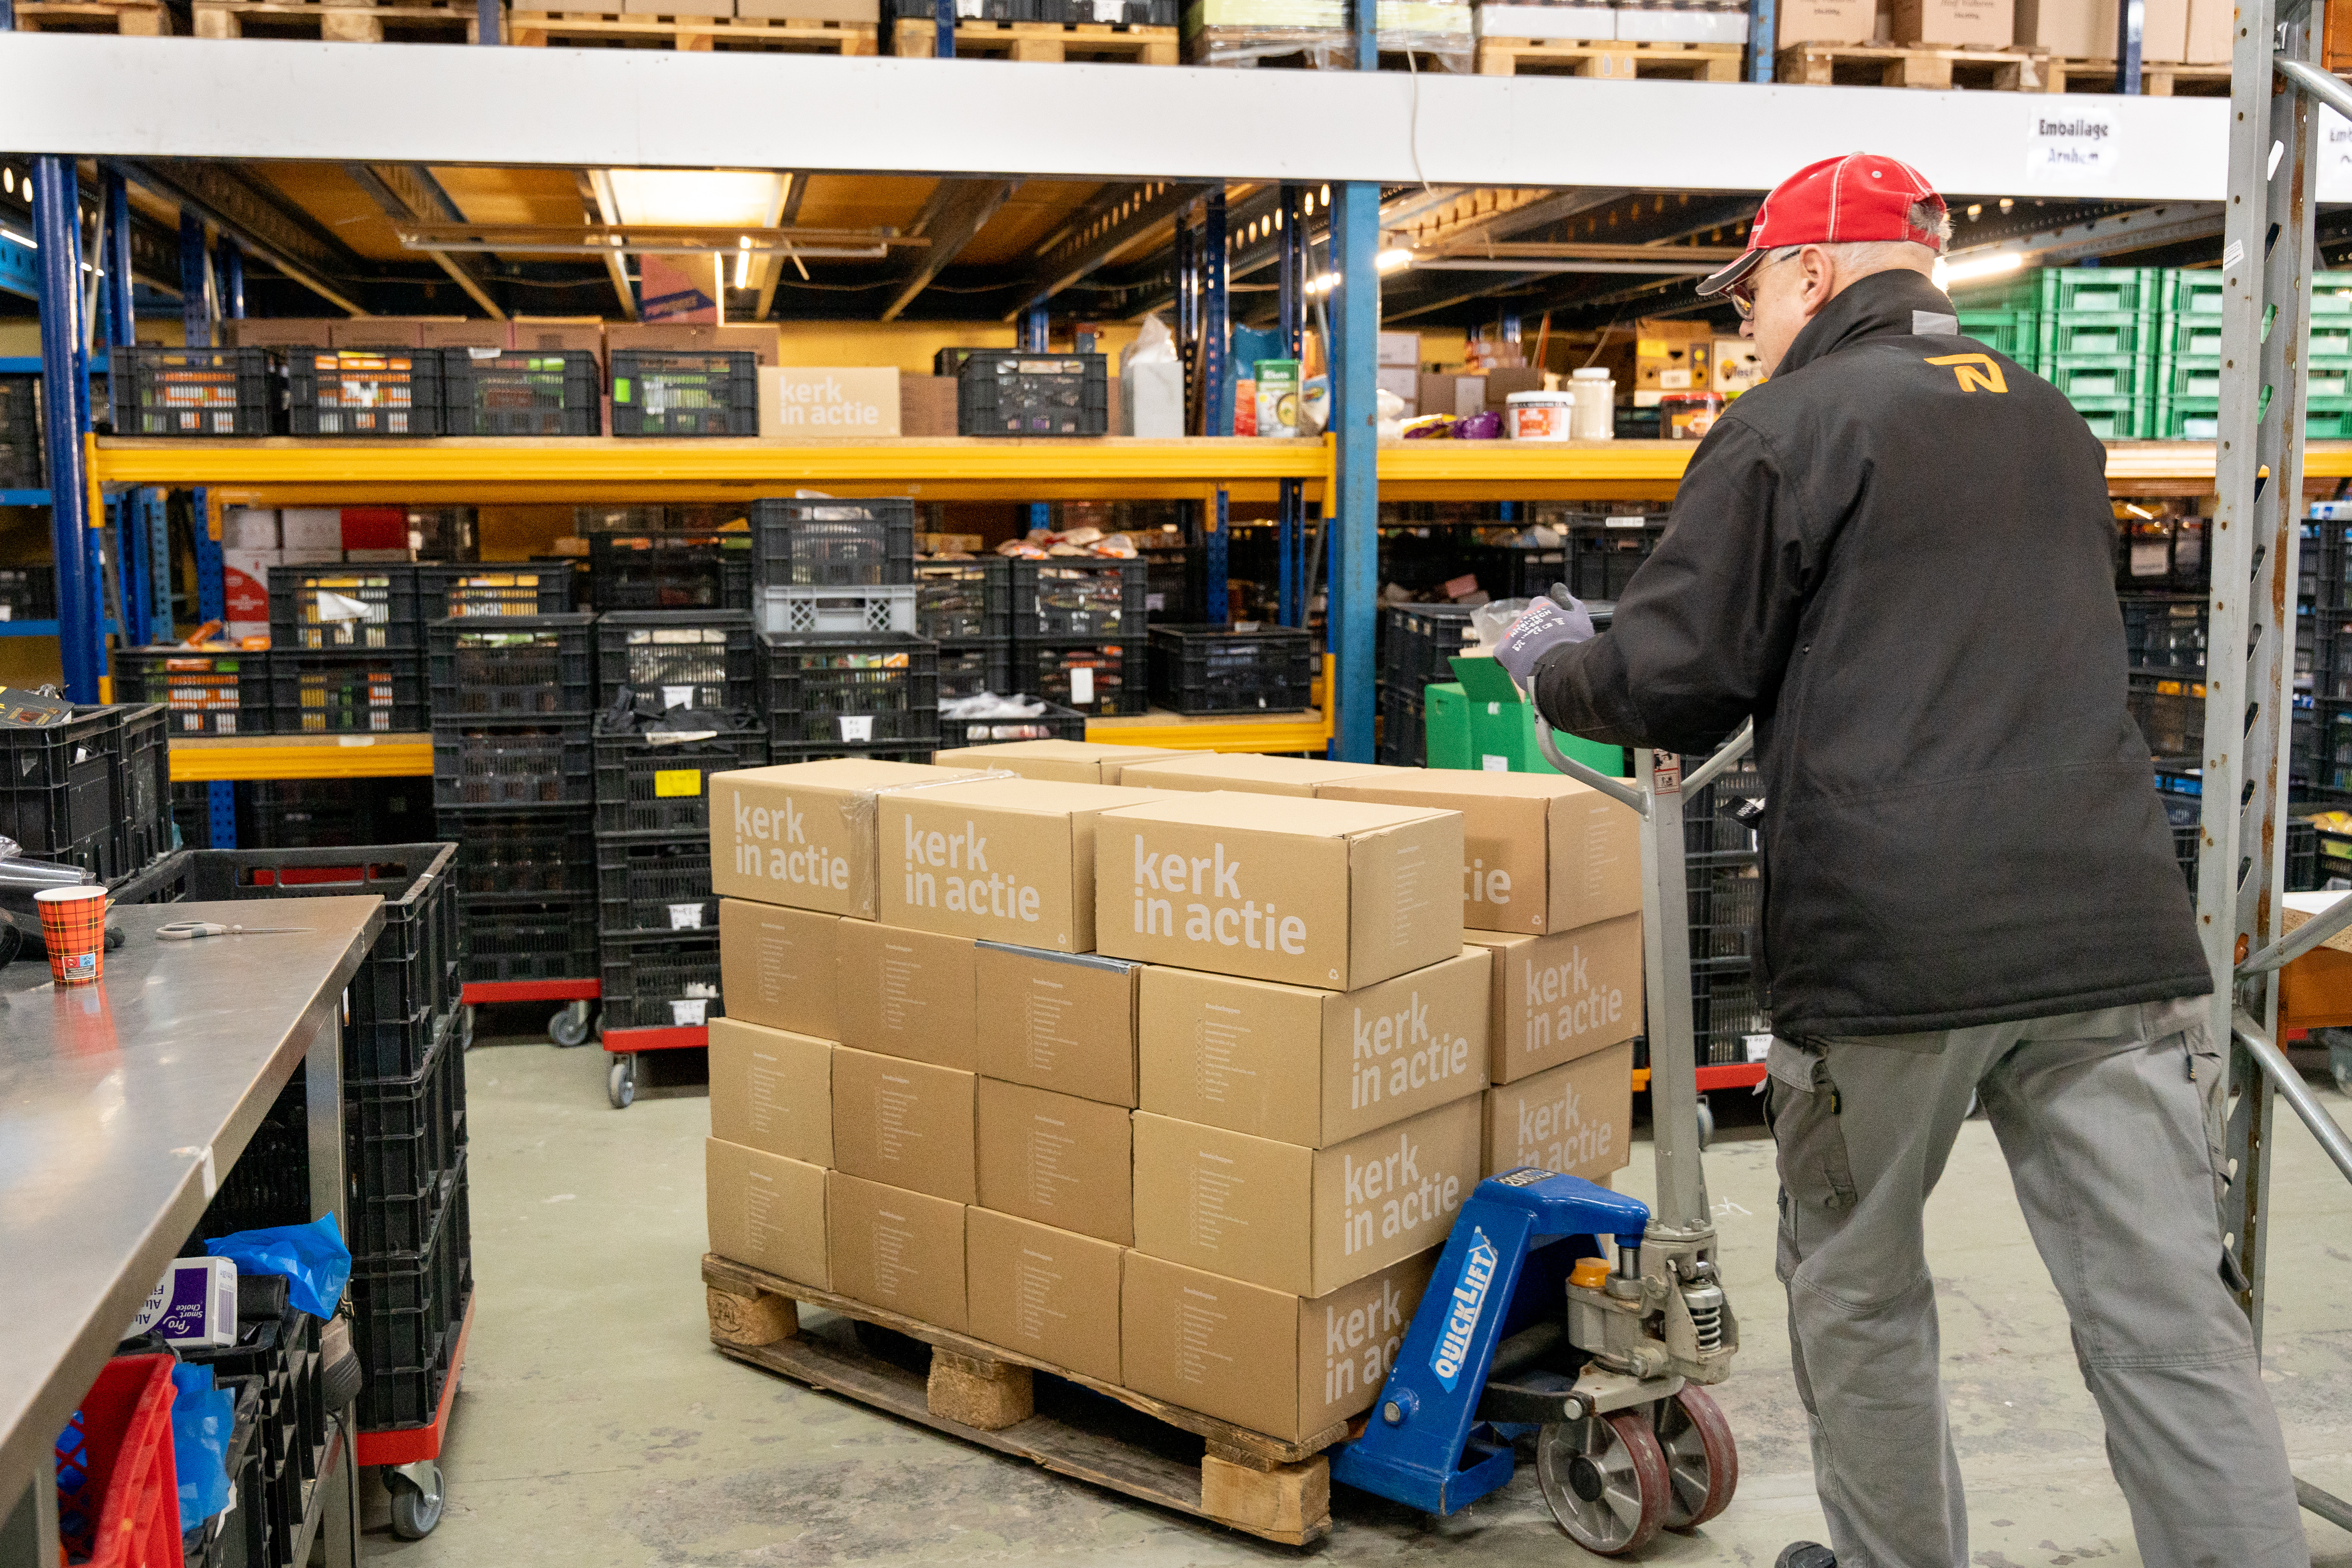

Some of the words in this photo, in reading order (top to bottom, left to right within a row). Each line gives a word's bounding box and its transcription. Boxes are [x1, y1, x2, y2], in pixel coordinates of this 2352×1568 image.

[2039, 119, 2109, 141] Emballage
[779, 375, 842, 403] kerk
[780, 401, 804, 425] in
[811, 401, 879, 425] actie
[733, 790, 806, 844] kerk
[905, 814, 988, 872] kerk
[735, 835, 762, 876] in
[770, 845, 849, 890] actie
[905, 862, 936, 907] in
[945, 873, 1040, 922] actie
[1134, 834, 1241, 900] kerk
[1134, 887, 1173, 937] in
[1185, 900, 1306, 955] actie
[1525, 945, 1589, 1006] kerk
[1353, 991, 1429, 1059] kerk
[1525, 1008, 1550, 1052] in
[1556, 985, 1623, 1041] actie
[1351, 1062, 1381, 1109] in
[1389, 1033, 1468, 1096] actie
[1518, 1083, 1581, 1146] kerk
[1345, 1134, 1419, 1206] kerk
[1547, 1119, 1612, 1174] actie
[1345, 1209, 1373, 1255] in
[1382, 1173, 1459, 1239] actie
[168, 1320, 186, 1330] Pro
[1326, 1279, 1402, 1356] kerk
[1435, 1250, 1493, 1378] QUICKLIFT
[1325, 1357, 1355, 1405] in
